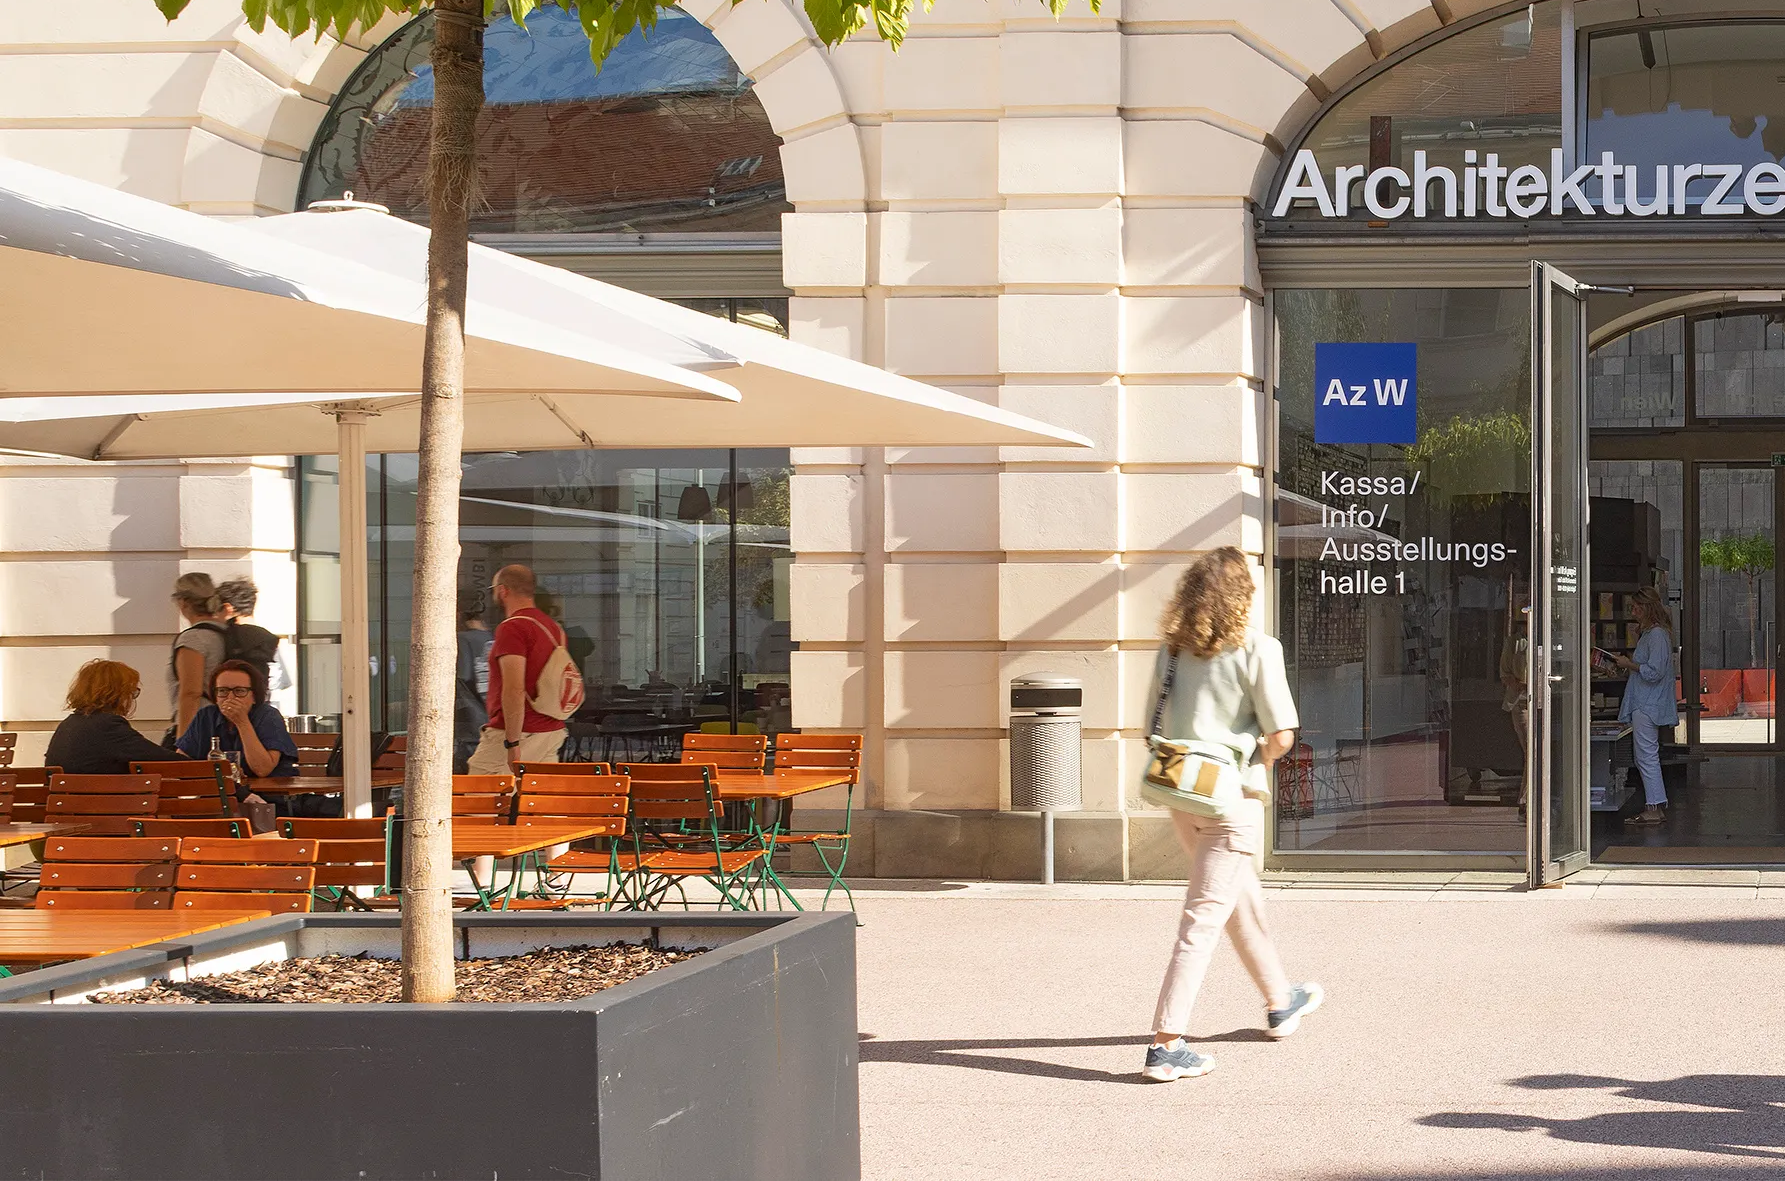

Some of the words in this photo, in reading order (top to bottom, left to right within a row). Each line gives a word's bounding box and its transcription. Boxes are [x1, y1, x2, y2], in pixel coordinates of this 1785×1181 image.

[1323, 379, 1367, 406] Az
[1373, 378, 1408, 406] W
[1319, 537, 1517, 567] Ausstellungs-
[1321, 570, 1387, 594] halle
[1395, 571, 1405, 594] 1
